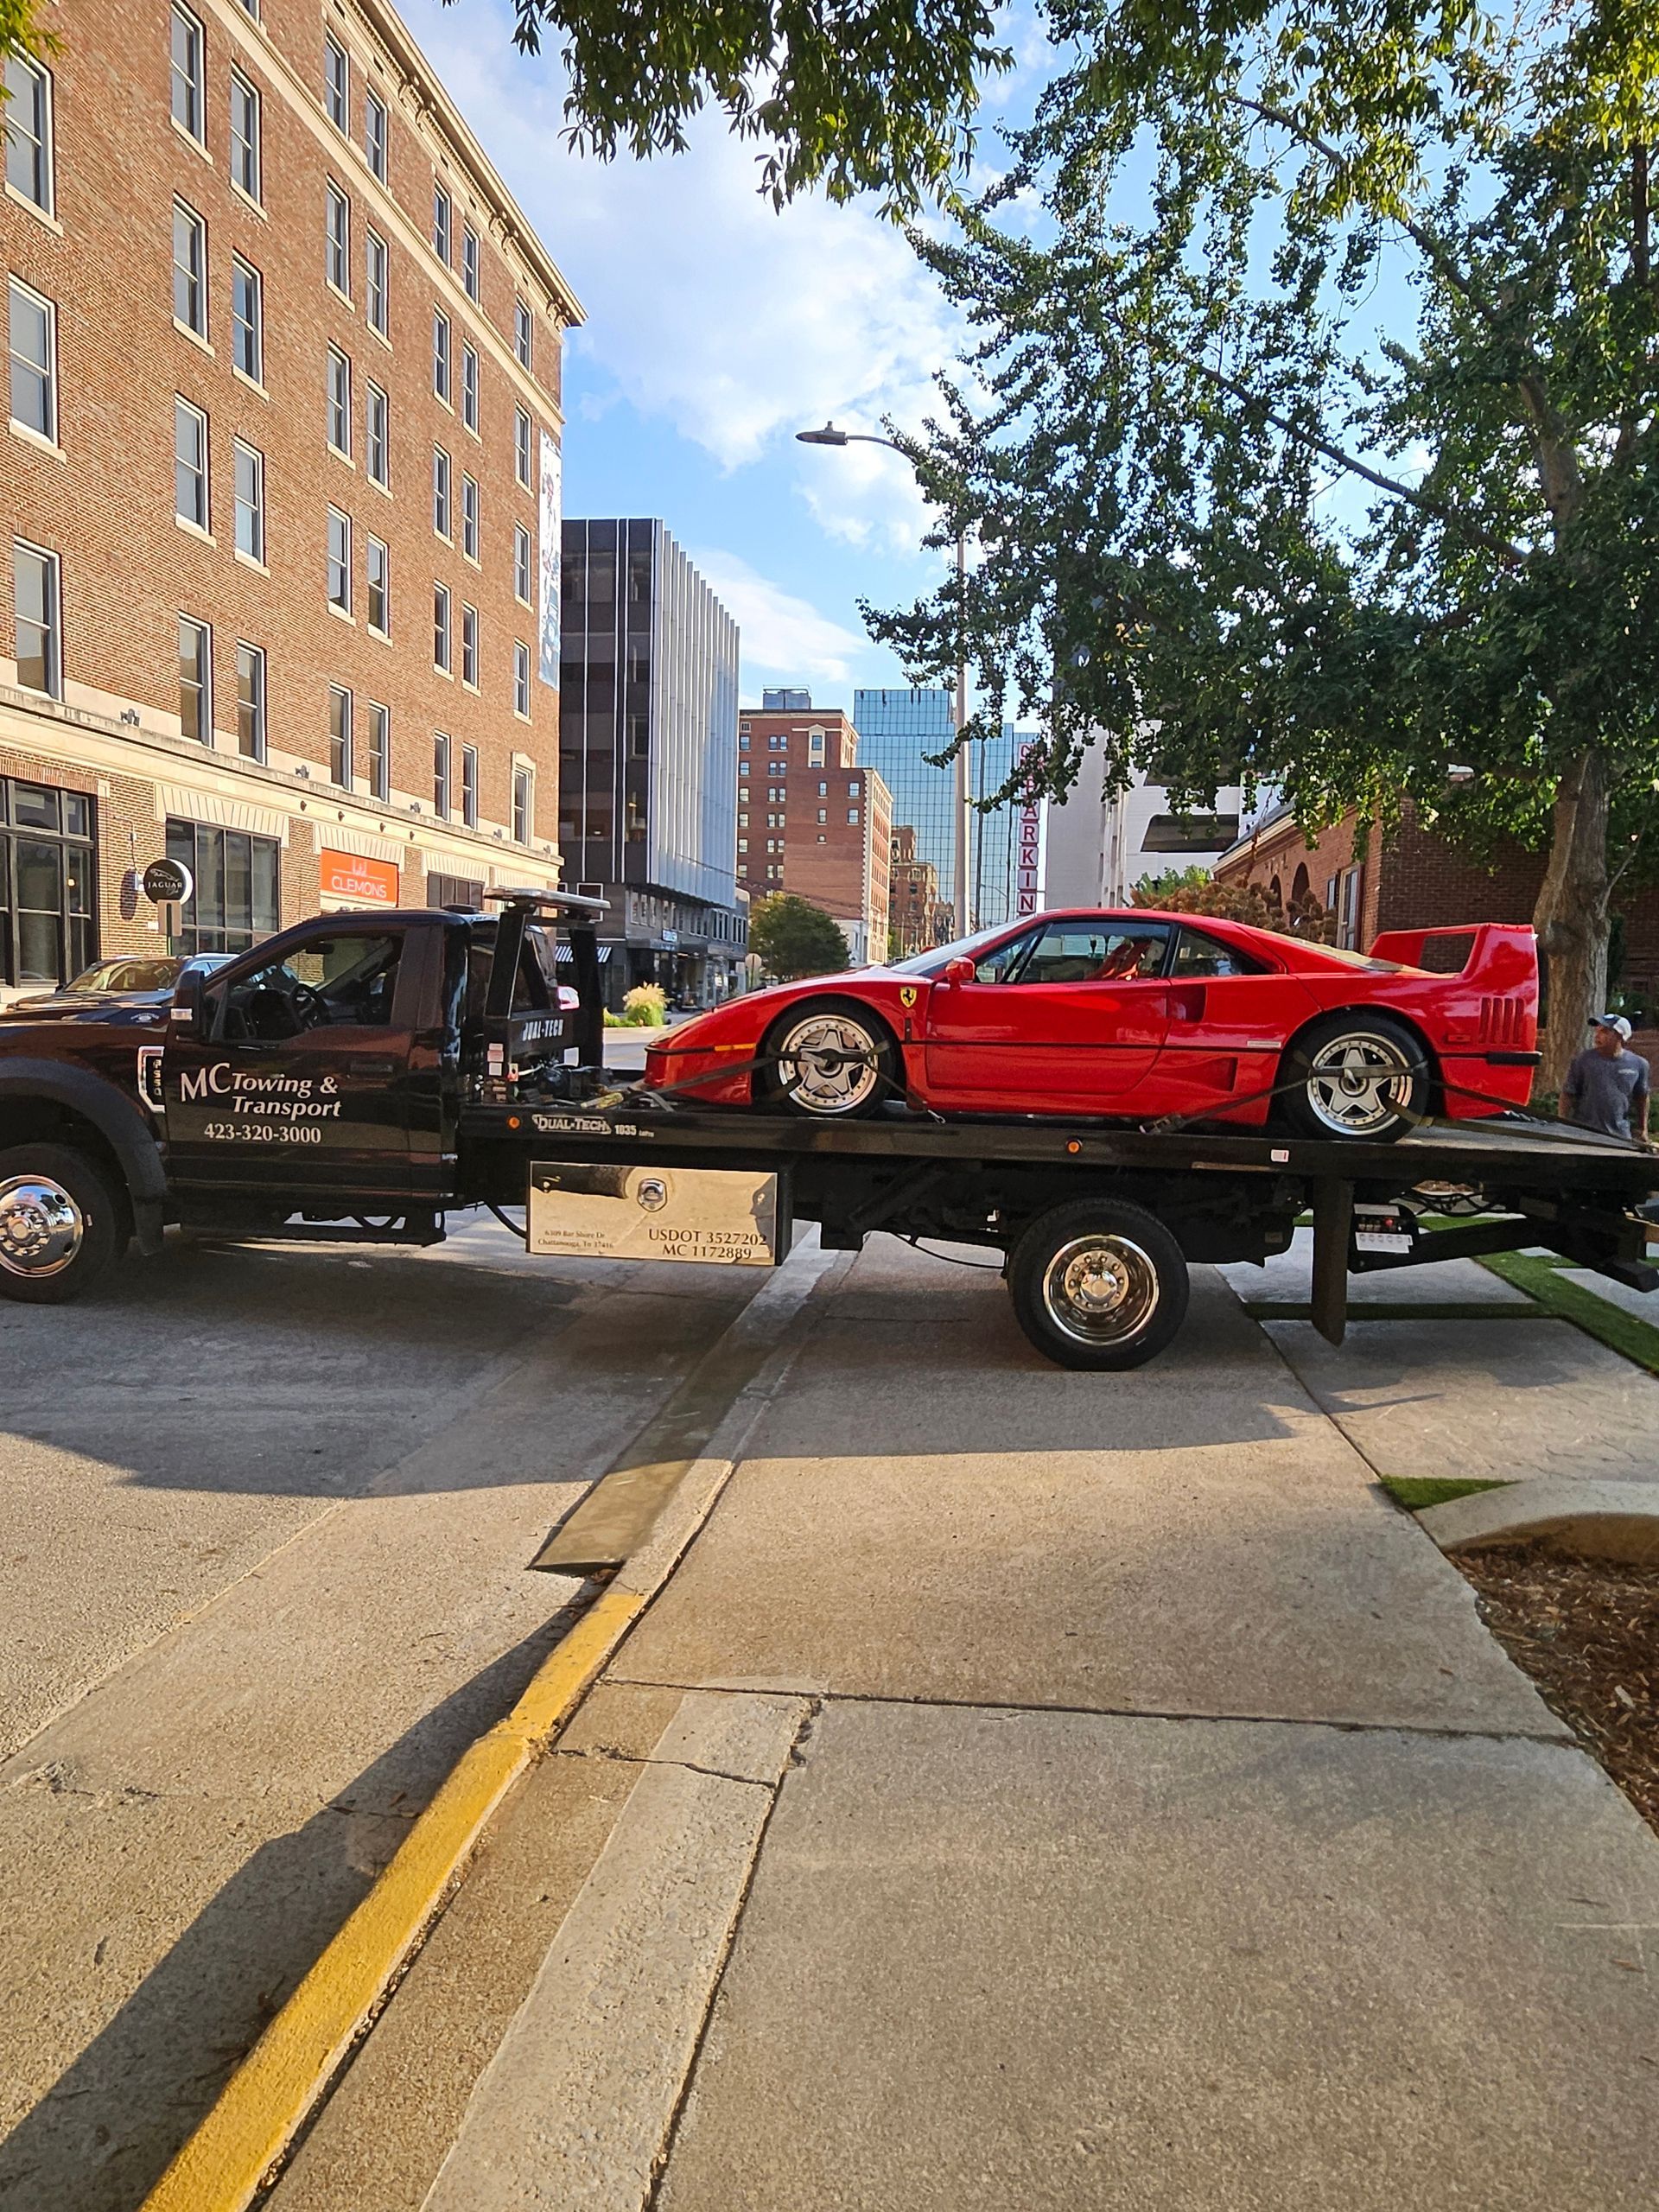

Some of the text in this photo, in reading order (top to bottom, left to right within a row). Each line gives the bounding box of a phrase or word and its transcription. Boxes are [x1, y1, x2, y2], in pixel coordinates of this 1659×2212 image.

[331, 875, 388, 899] CLEMONS
[181, 1063, 339, 1103] MC Towing &
[232, 1096, 342, 1121] Transport
[204, 1123, 322, 1143] 423-320-3000
[614, 1124, 637, 1135] 1035
[649, 1229, 767, 1245] USDOT 3527202
[662, 1244, 752, 1259] MC 1172889
